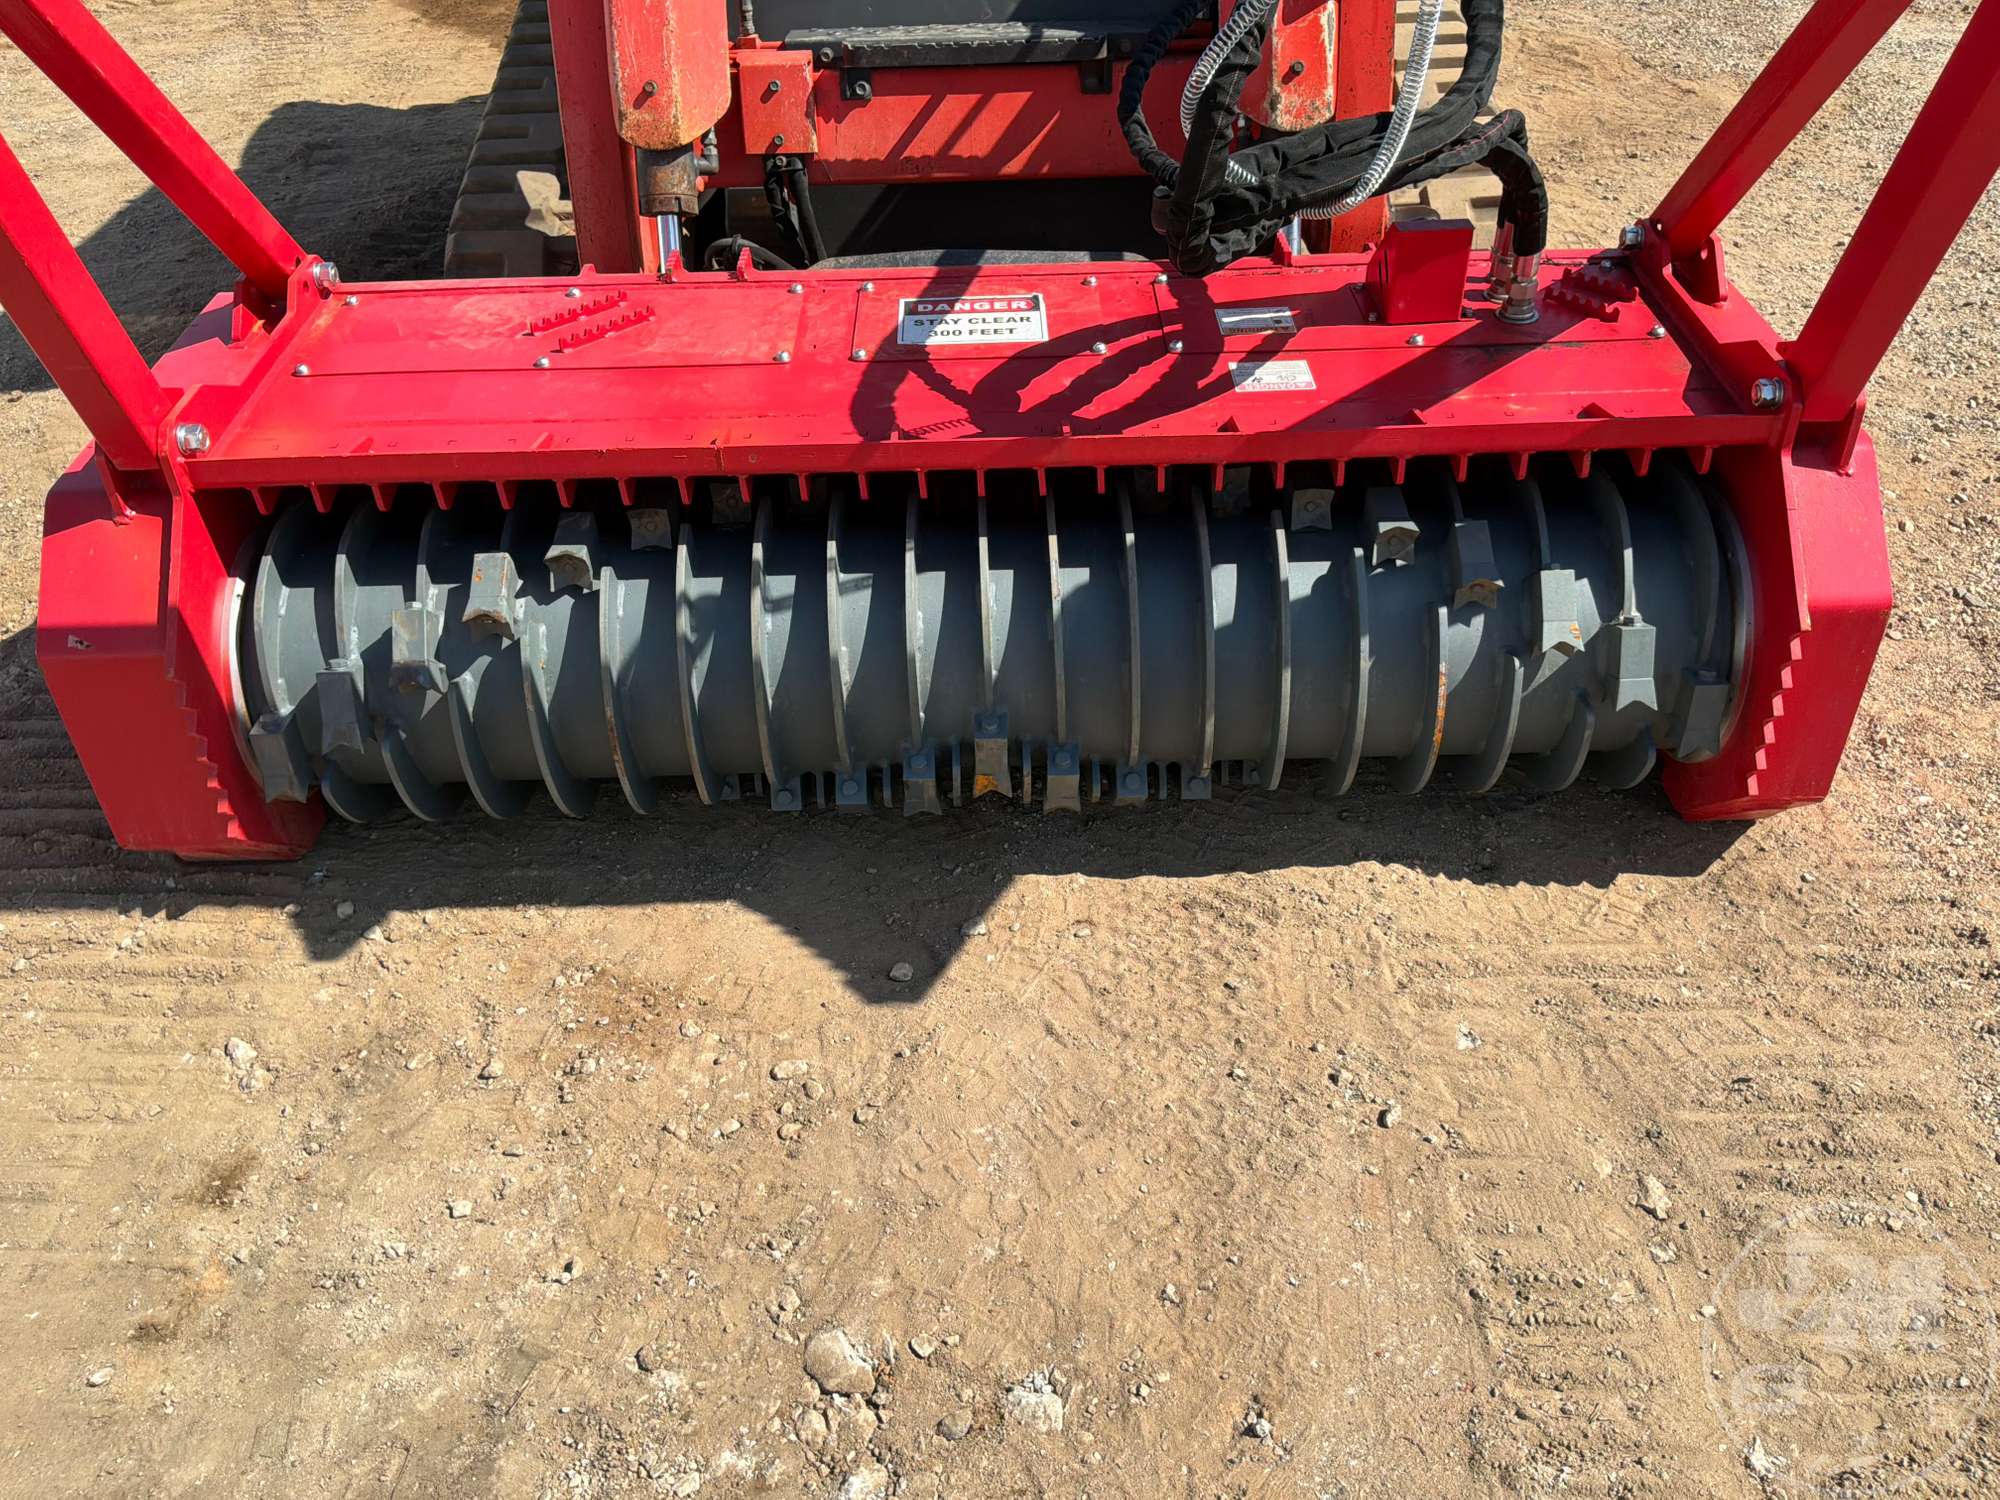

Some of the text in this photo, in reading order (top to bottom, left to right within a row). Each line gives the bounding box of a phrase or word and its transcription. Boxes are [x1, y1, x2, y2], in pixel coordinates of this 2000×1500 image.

[917, 300, 1028, 312] DANGER
[913, 316, 1032, 327] STAY CLEAR
[928, 327, 1017, 337] 300 FEET
